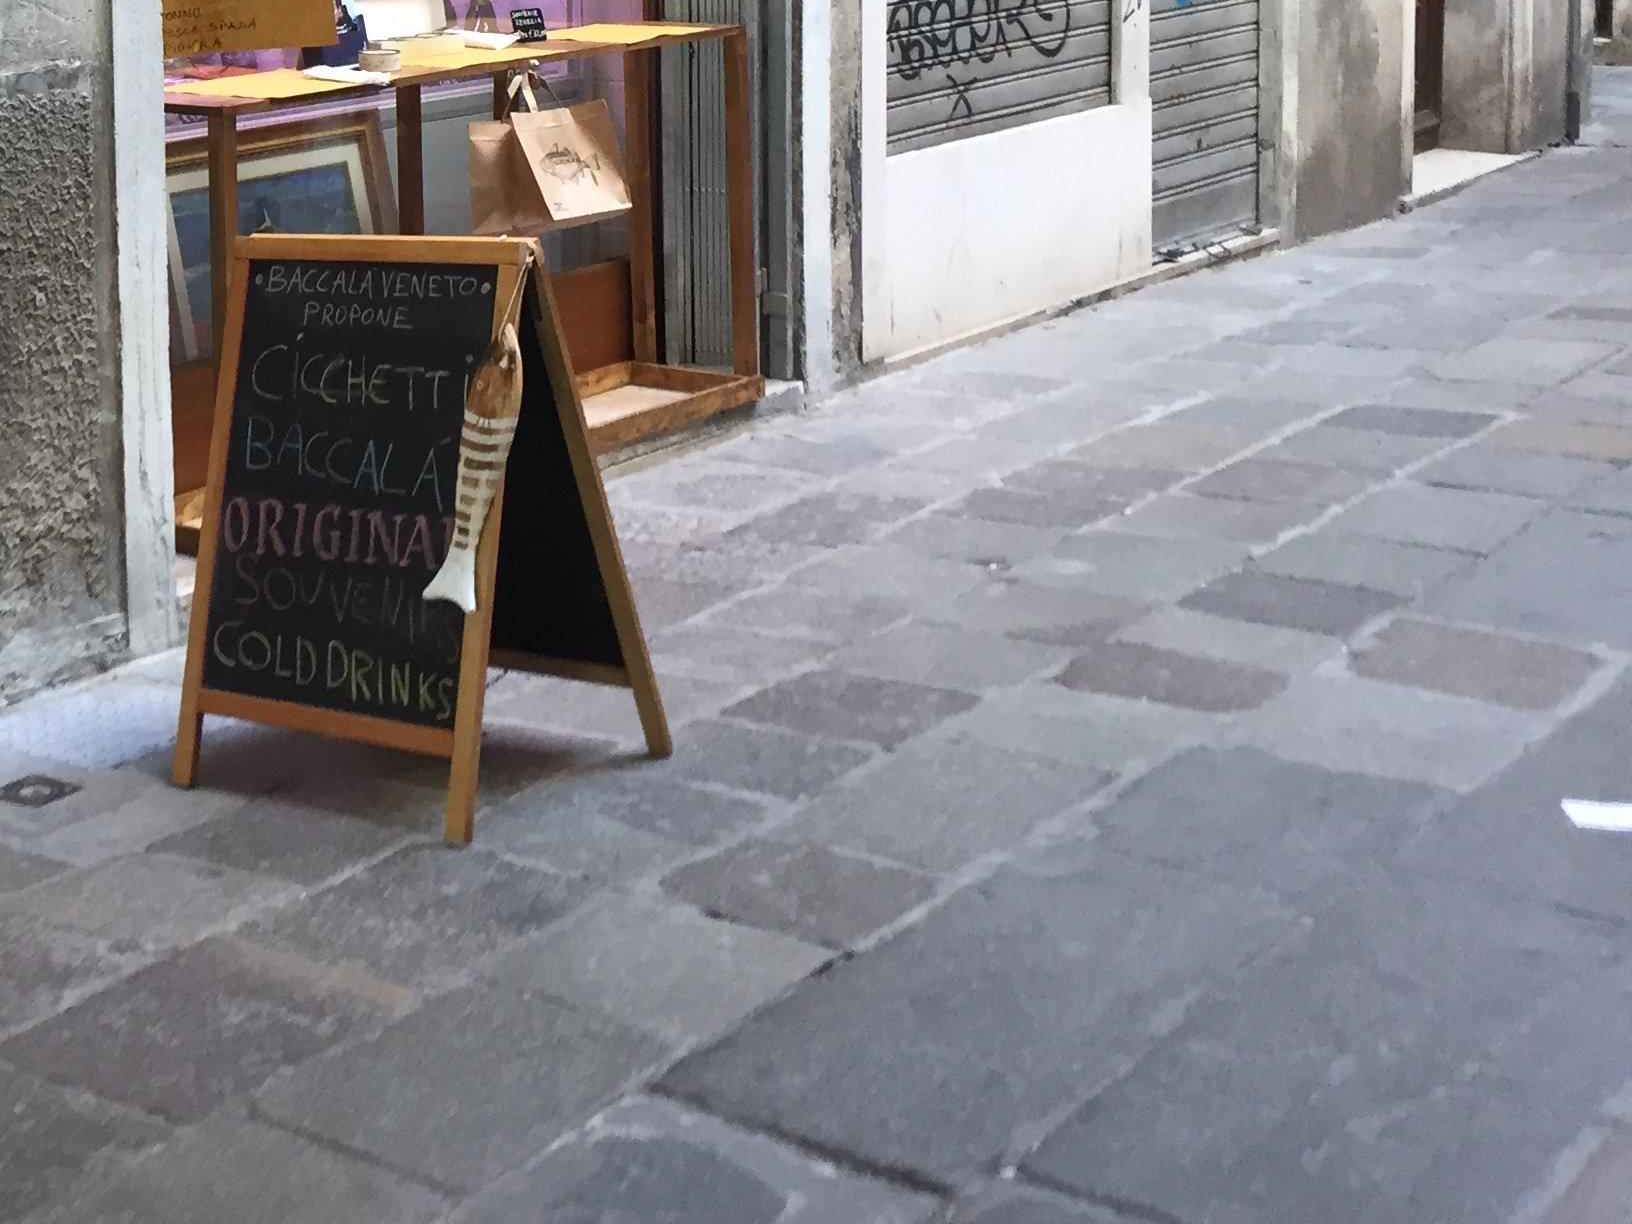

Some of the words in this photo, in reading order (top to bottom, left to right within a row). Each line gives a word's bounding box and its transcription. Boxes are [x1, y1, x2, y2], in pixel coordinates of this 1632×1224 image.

[381, 269, 478, 300] VENETO
[304, 301, 414, 330] PROPONE
[213, 620, 317, 686] COLD
[326, 639, 454, 720] DRINKS
